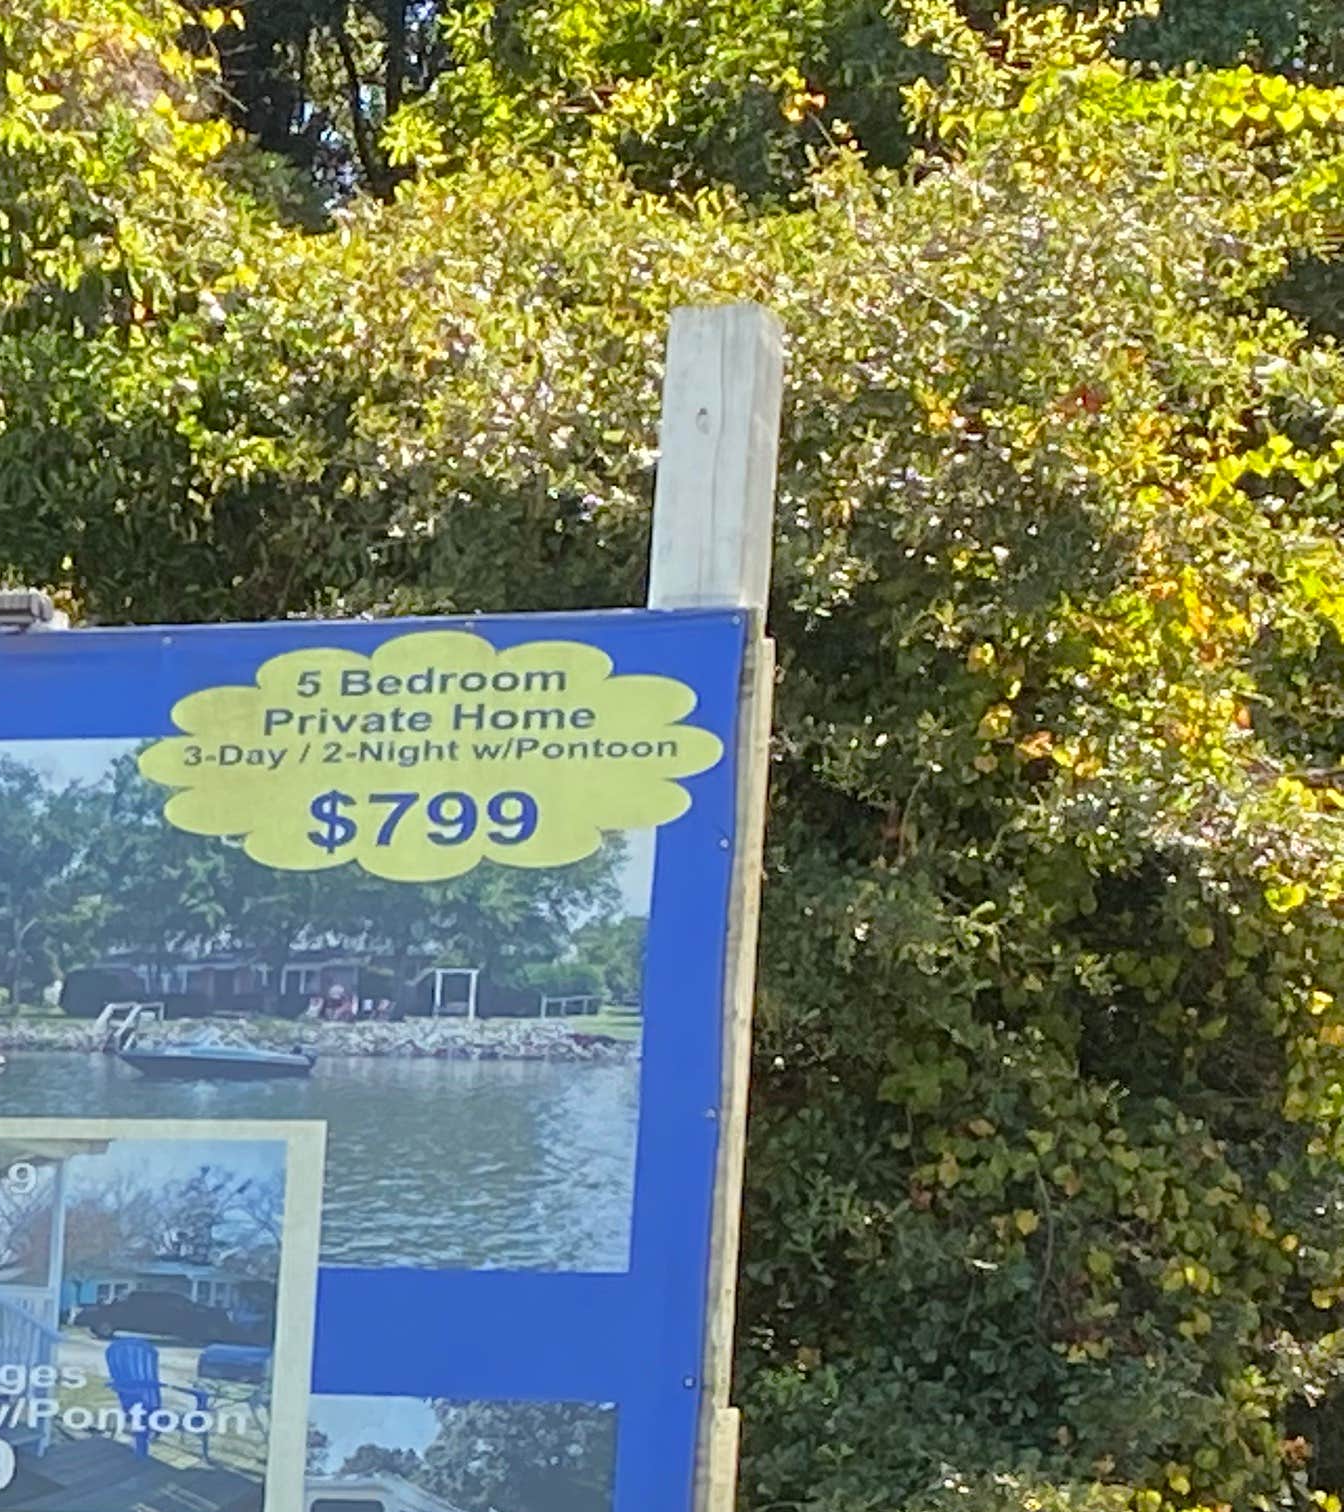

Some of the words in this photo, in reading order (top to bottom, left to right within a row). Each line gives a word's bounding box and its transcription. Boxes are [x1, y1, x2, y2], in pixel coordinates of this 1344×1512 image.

[297, 669, 320, 698] 5
[341, 667, 567, 696] Bedroom
[263, 704, 433, 737] Private
[453, 703, 597, 732] Home
[184, 743, 288, 771] 3-Day
[299, 743, 312, 766] /
[322, 740, 459, 769] 2-Night
[473, 738, 679, 762] w/Pontoon
[309, 789, 540, 853] $799
